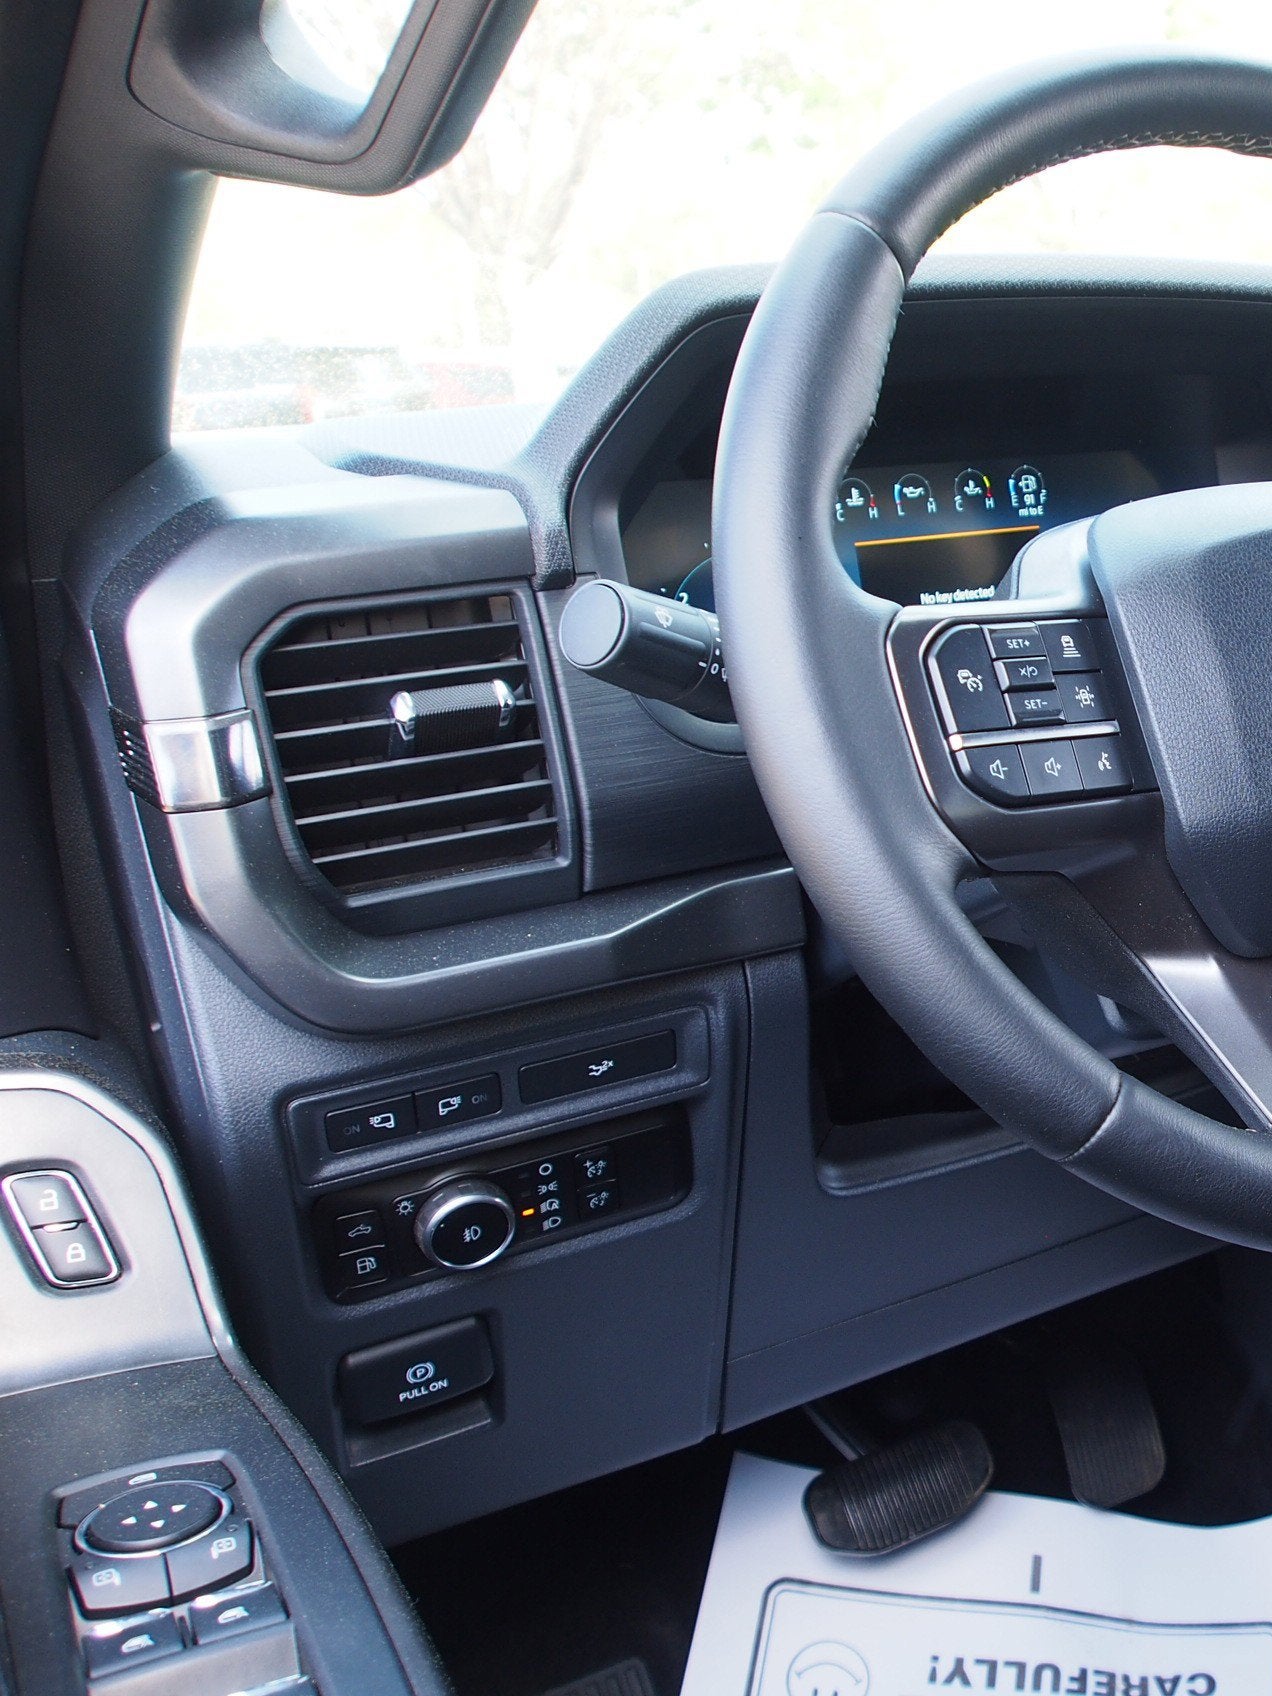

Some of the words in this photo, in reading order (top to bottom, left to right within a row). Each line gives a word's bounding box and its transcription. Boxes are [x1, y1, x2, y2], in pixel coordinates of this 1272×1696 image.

[956, 500, 964, 512] C
[986, 497, 995, 509] H
[1011, 494, 1019, 506] E
[1023, 493, 1035, 505] 91
[1040, 492, 1047, 504] F
[837, 510, 845, 521] C
[869, 507, 878, 519] H
[897, 504, 906, 516] L
[928, 502, 937, 513] H
[1018, 507, 1029, 516] mi
[1029, 506, 1037, 516] to
[1037, 505, 1044, 515] E
[920, 592, 936, 605] No
[935, 591, 953, 605] key
[953, 584, 996, 602] detected
[1006, 638, 1030, 650] SET+
[471, 1093, 487, 1105] ON
[343, 1124, 361, 1136] ON
[399, 1386, 428, 1402] PULL
[429, 1378, 448, 1392] ON
[927, 1654, 1218, 1696] CAREFULLY!
